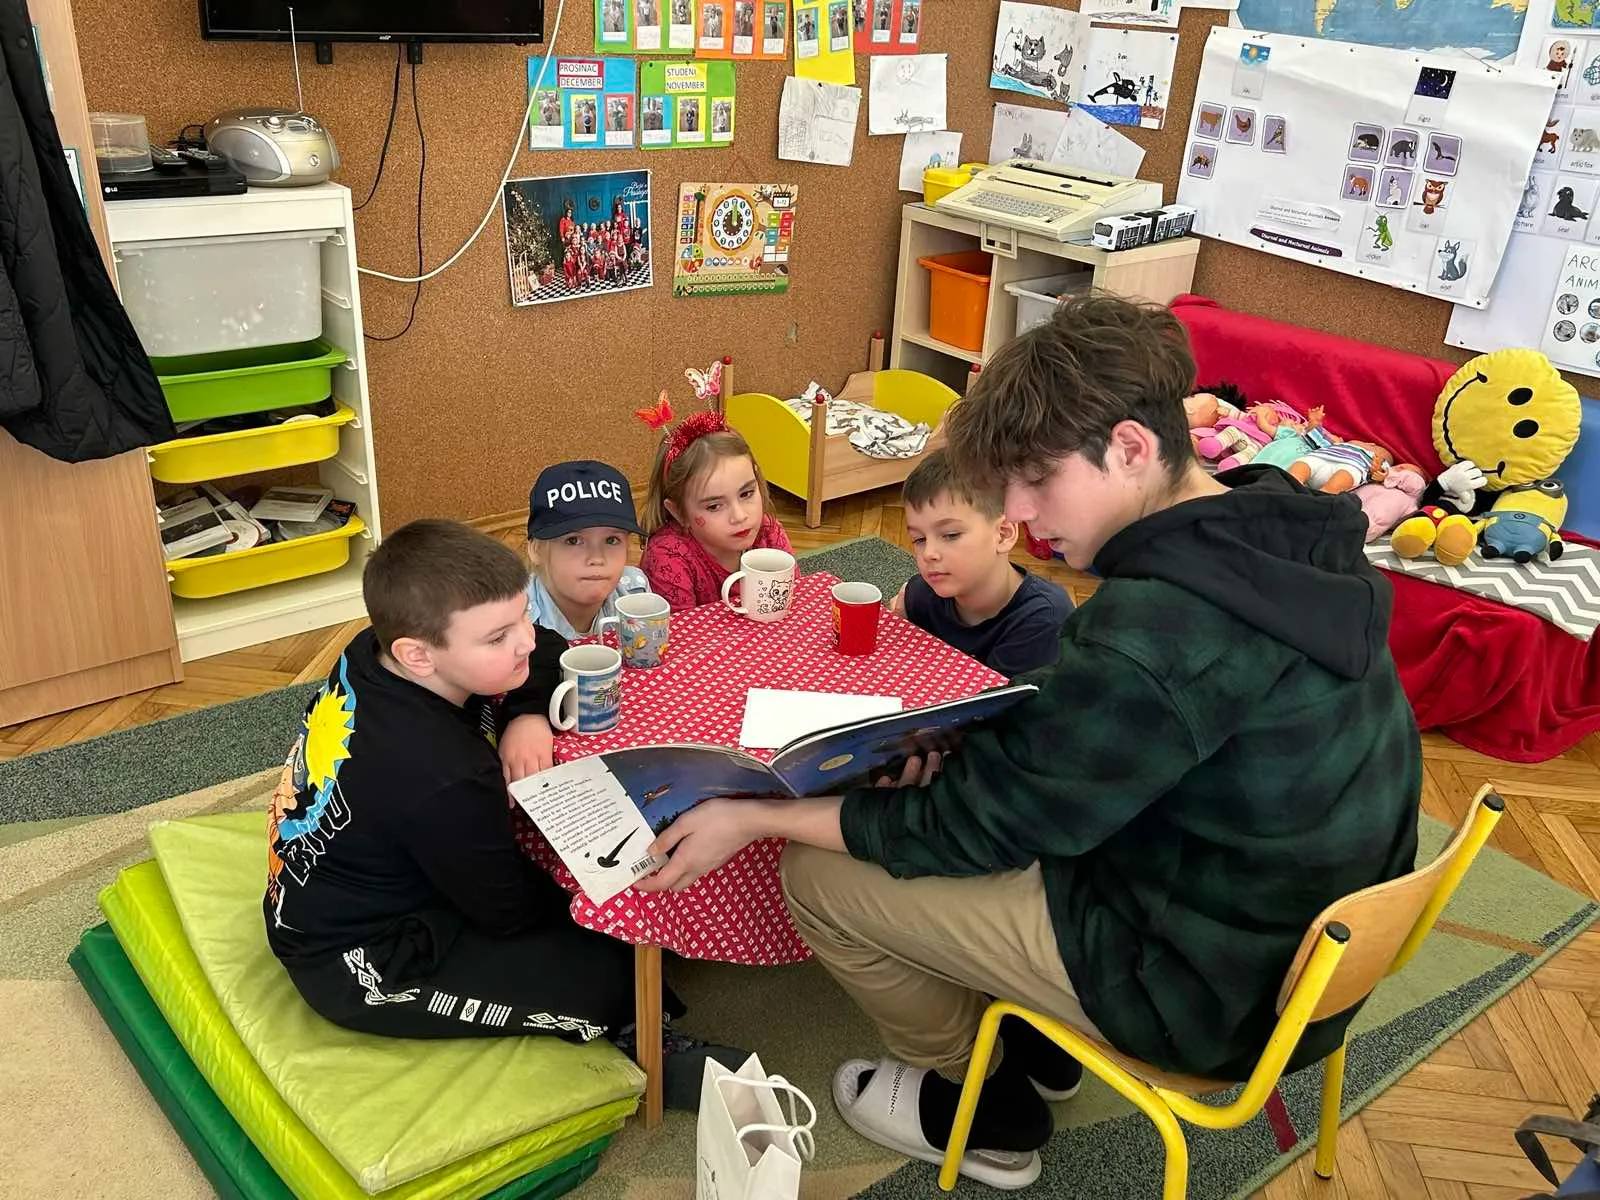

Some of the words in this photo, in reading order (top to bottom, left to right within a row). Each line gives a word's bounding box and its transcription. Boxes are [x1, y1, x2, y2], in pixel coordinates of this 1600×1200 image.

[559, 63, 598, 74] PROSINAC
[667, 68, 697, 76] STUDENI
[560, 78, 602, 87] DECEMBER
[666, 81, 705, 90] NOVEMBER
[1567, 254, 1599, 272] ARC
[1565, 275, 1599, 289] ANIM
[546, 480, 623, 508] POLICE
[522, 1021, 556, 1030] UMBRO
